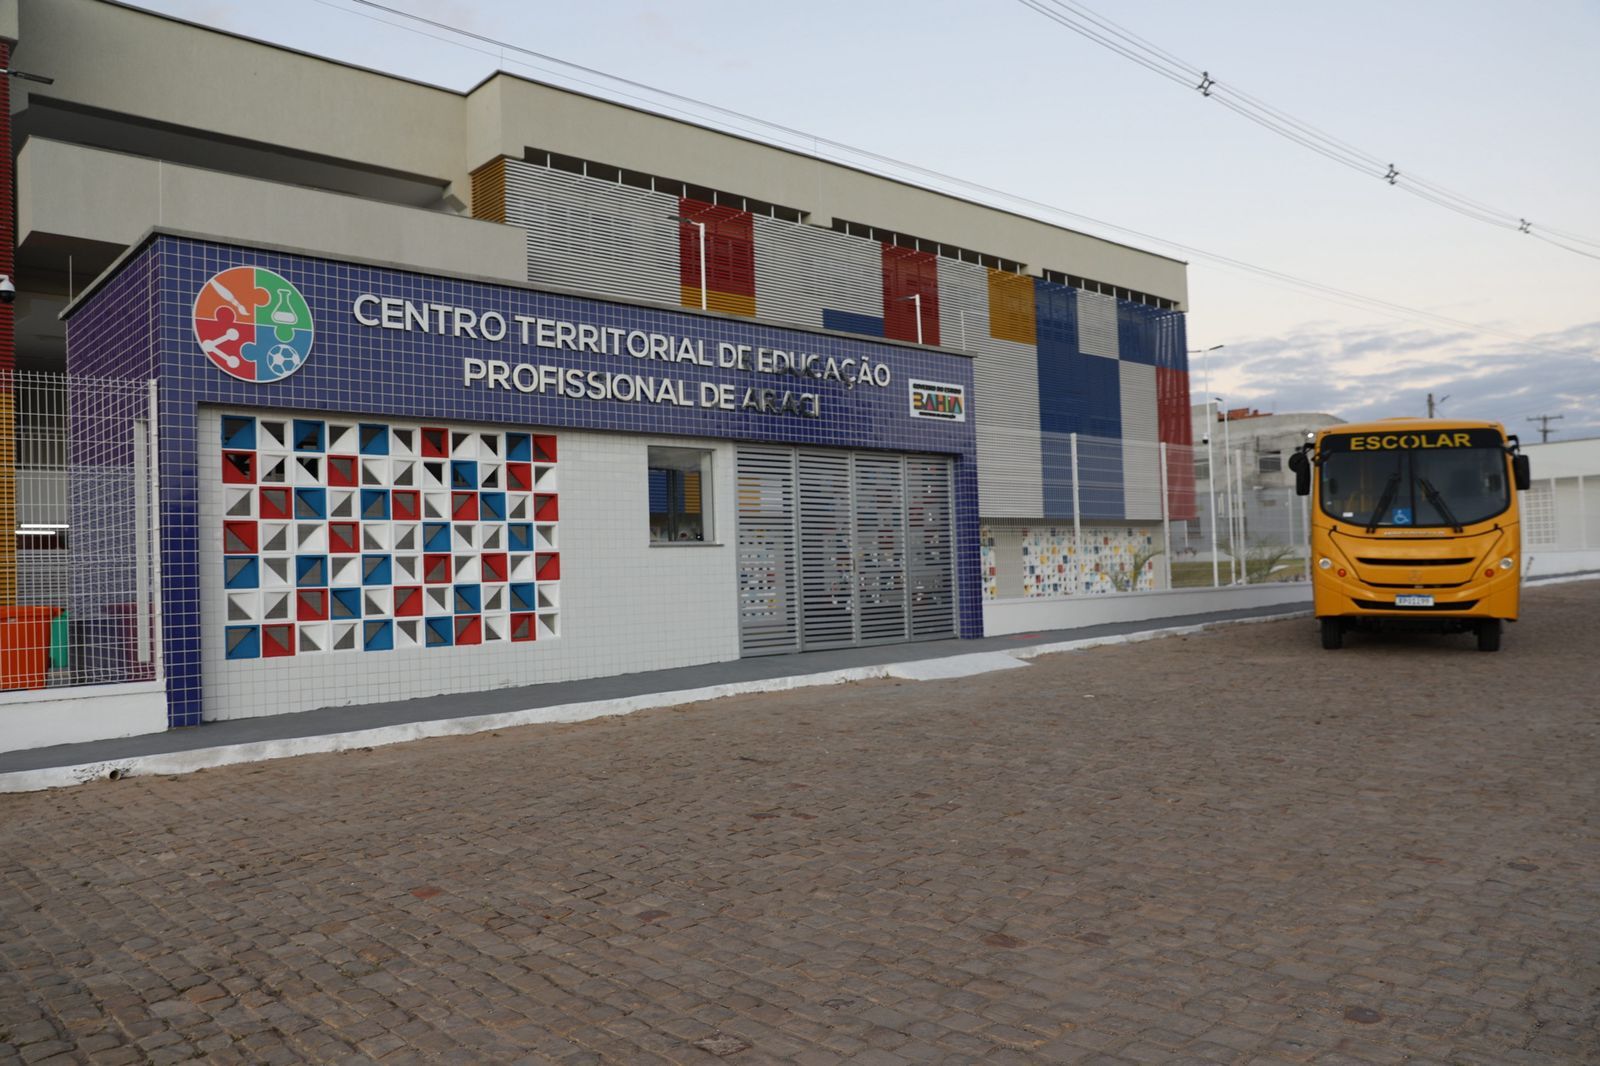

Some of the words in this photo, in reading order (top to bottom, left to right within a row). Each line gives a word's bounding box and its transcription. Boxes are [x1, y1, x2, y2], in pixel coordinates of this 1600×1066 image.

[353, 293, 507, 342] CENTRO
[514, 315, 713, 368] TERRITORIAL
[719, 342, 752, 371] DE
[757, 347, 891, 390] EDUCAÇÃO
[464, 357, 694, 408] PROFISSIONAL
[700, 381, 736, 411] DE
[741, 385, 820, 418] ARACI
[913, 392, 962, 414] BAHIA
[1350, 432, 1473, 451] ESCOLAR
